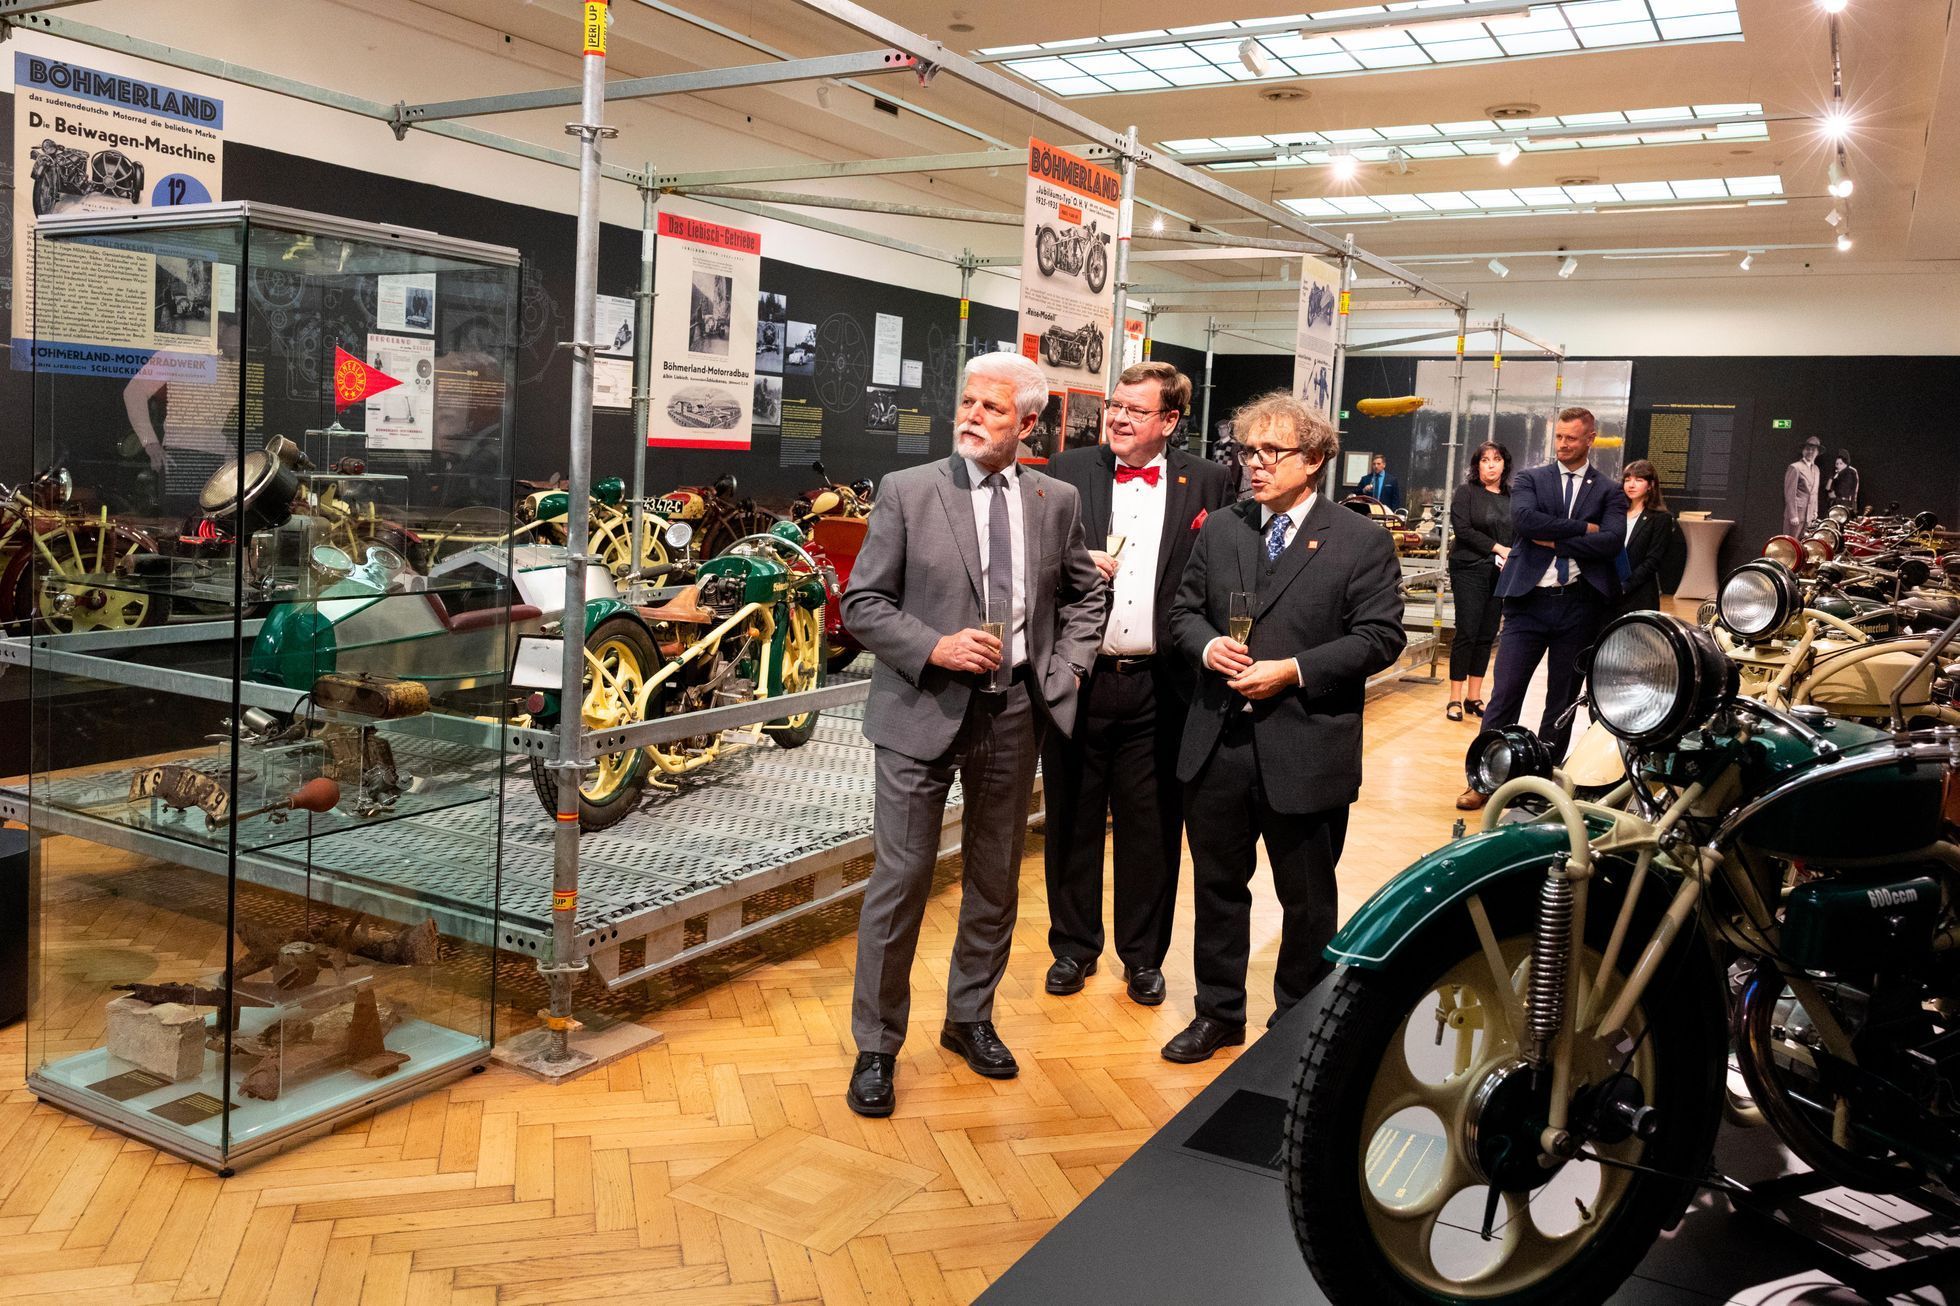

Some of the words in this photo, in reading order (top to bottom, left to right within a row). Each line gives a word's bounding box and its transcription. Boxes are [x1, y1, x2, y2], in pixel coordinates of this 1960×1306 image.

[588, 5, 598, 20] UP
[588, 24, 597, 44] PERI
[29, 58, 217, 122] BÖHMERLAND
[29, 93, 43, 102] das
[112, 110, 147, 124] Motorrad
[150, 118, 162, 128] die
[164, 122, 193, 134] beliebte
[195, 129, 217, 140] Marke
[29, 112, 50, 129] Die
[54, 116, 216, 164] Beiwagen-Maschine
[1032, 147, 1119, 202] BÖHMERLAND
[168, 178, 186, 205] 12
[668, 216, 684, 235] Das
[688, 220, 755, 250] Liebisch-Getriebe
[90, 365, 153, 376] SCHLUCKENAU
[663, 361, 749, 378] Böhmerland-Motorradbau
[1867, 888, 1918, 908] 600ccm
